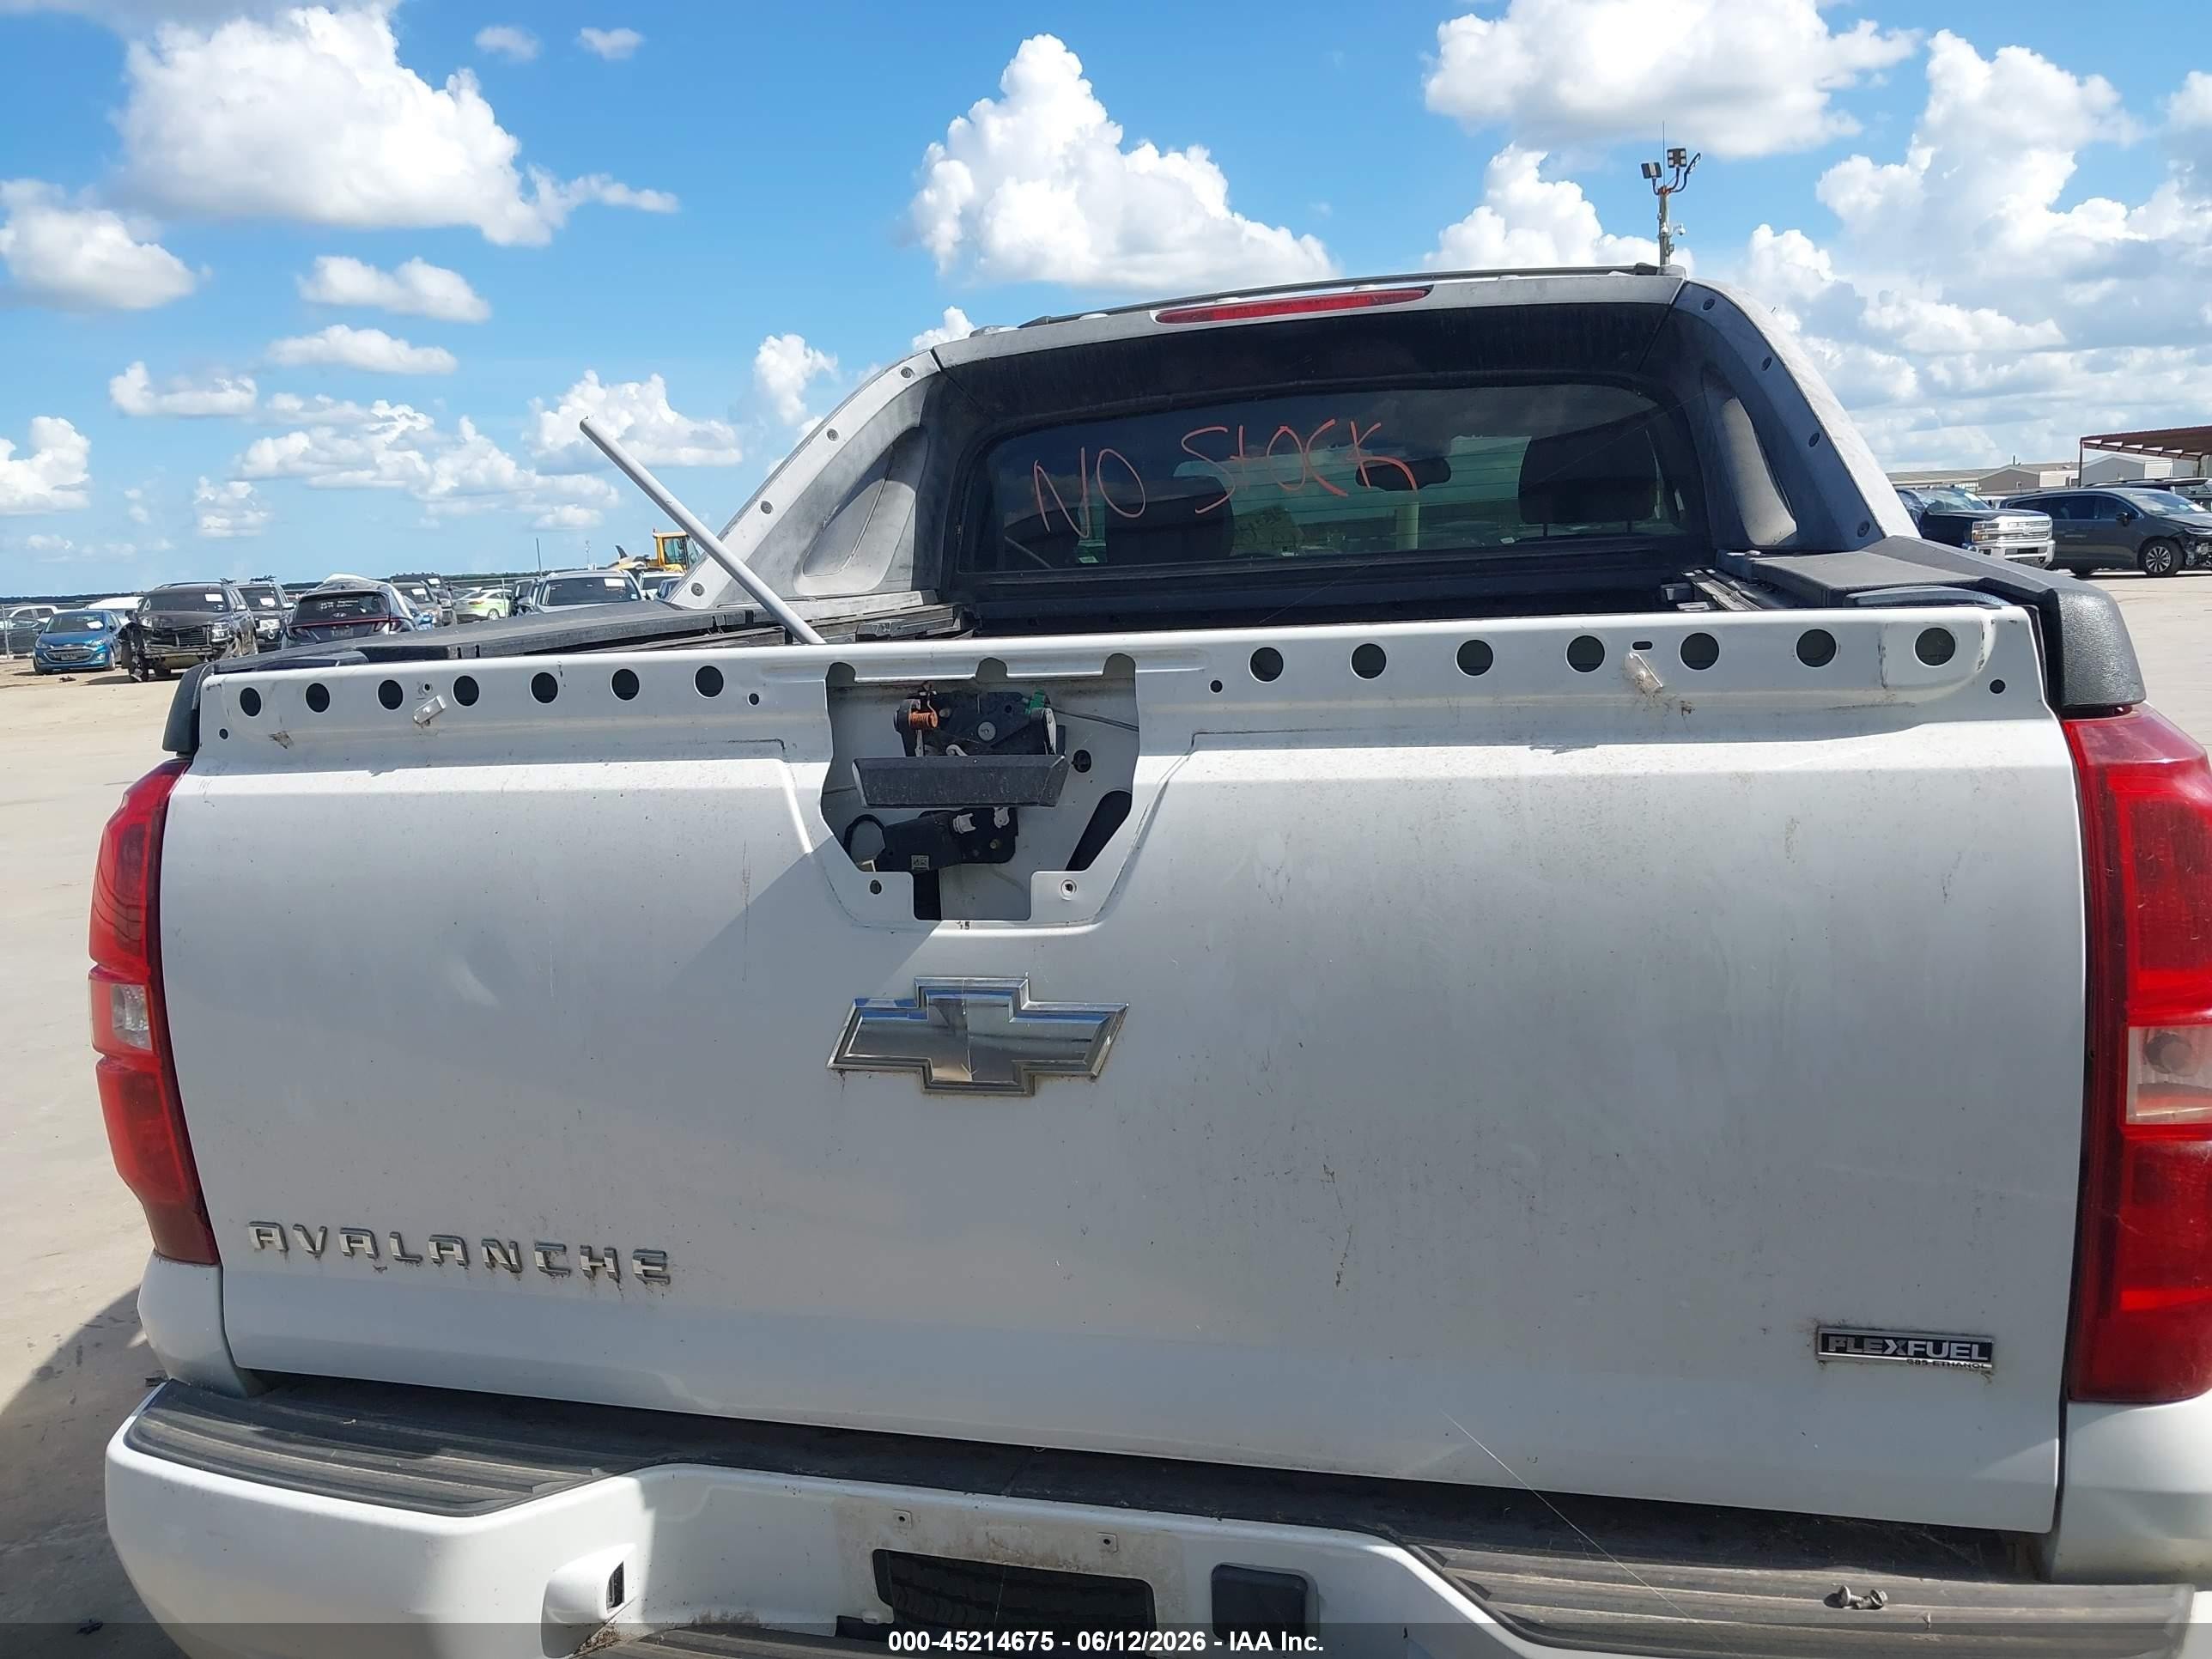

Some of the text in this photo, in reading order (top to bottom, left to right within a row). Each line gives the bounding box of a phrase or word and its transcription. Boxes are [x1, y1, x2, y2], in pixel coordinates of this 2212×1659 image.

[1033, 446, 1146, 538] NO
[247, 1220, 670, 1285] AVALANCHE
[1826, 1334, 1989, 1362] FLEXFUEL
